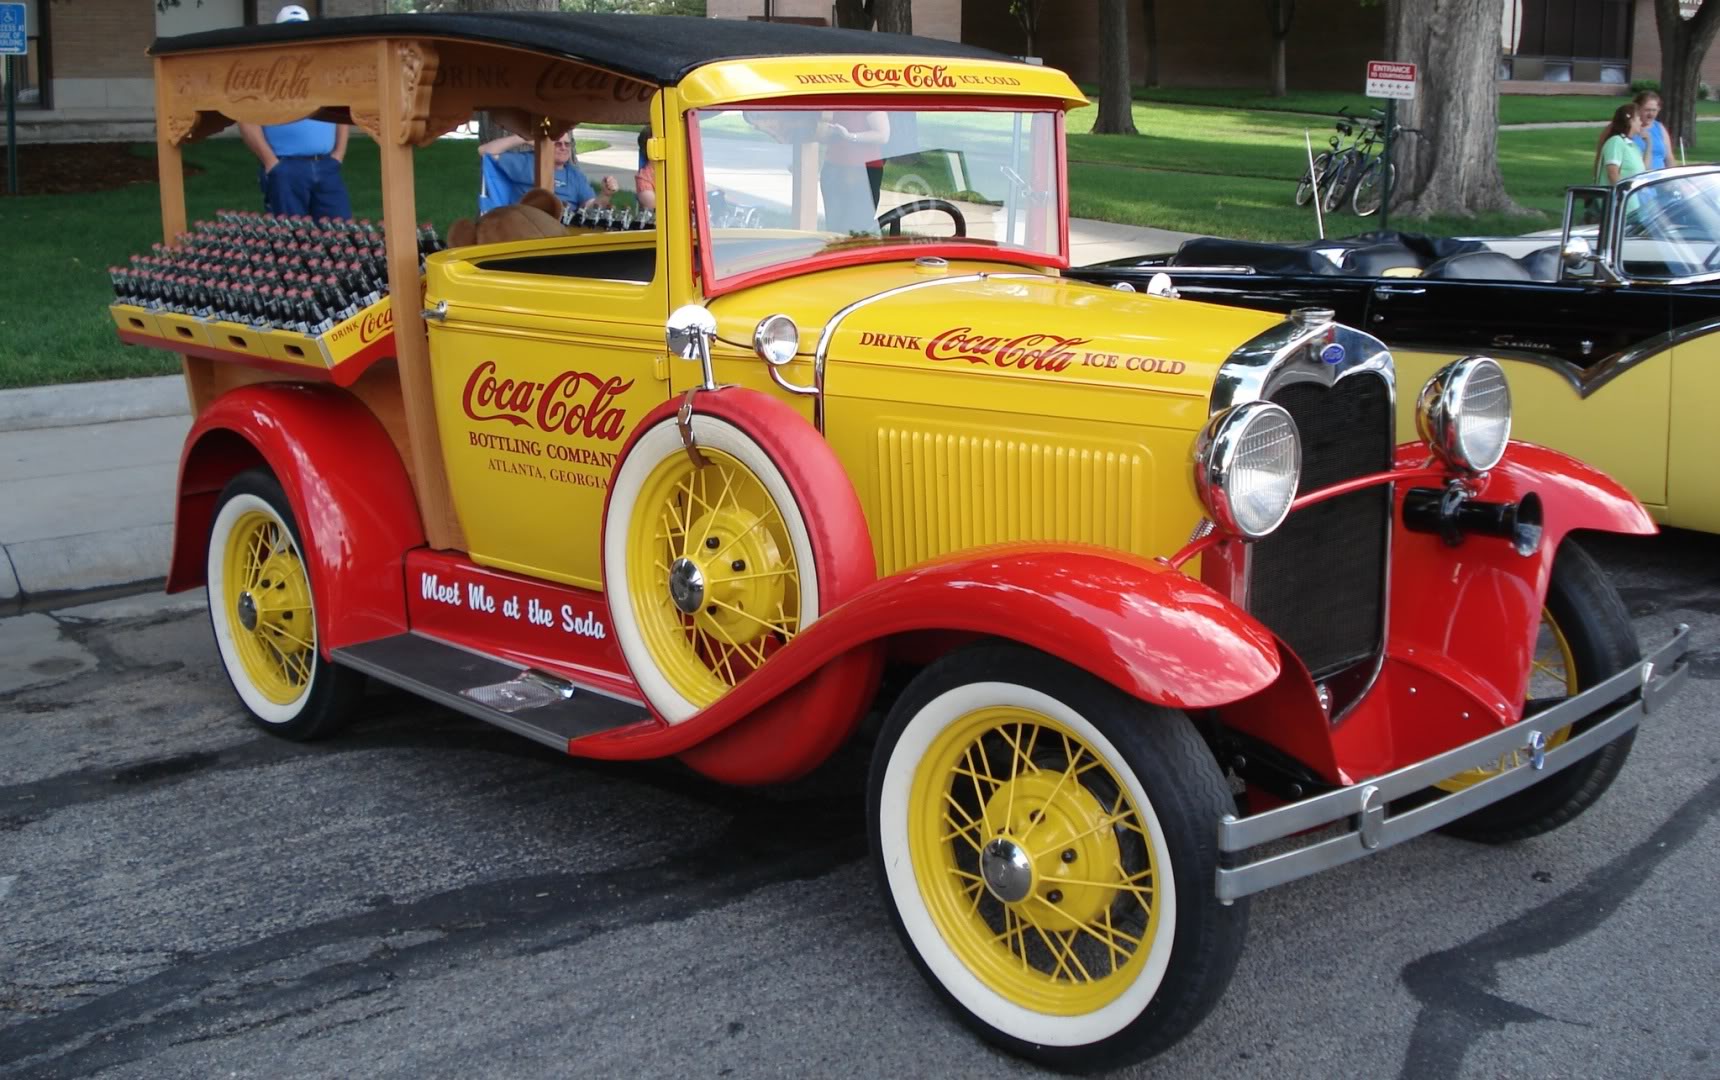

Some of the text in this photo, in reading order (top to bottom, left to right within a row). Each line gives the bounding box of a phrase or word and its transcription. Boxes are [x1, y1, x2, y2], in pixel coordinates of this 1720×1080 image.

[795, 63, 1021, 88] DRINK Coca-Cola ICE COLD
[1373, 64, 1411, 74] ENTRANCE
[1378, 72, 1413, 80] COURTHOUSE
[331, 320, 359, 342] DRINK
[859, 327, 1187, 375] DRINK Coca-Cola ICE COLD
[462, 360, 635, 441] Coca-Cola
[469, 431, 542, 456] BOTTLING
[488, 458, 609, 490] ATLANTA, GEORGIA
[421, 572, 606, 639] Meet Me at the Soda
